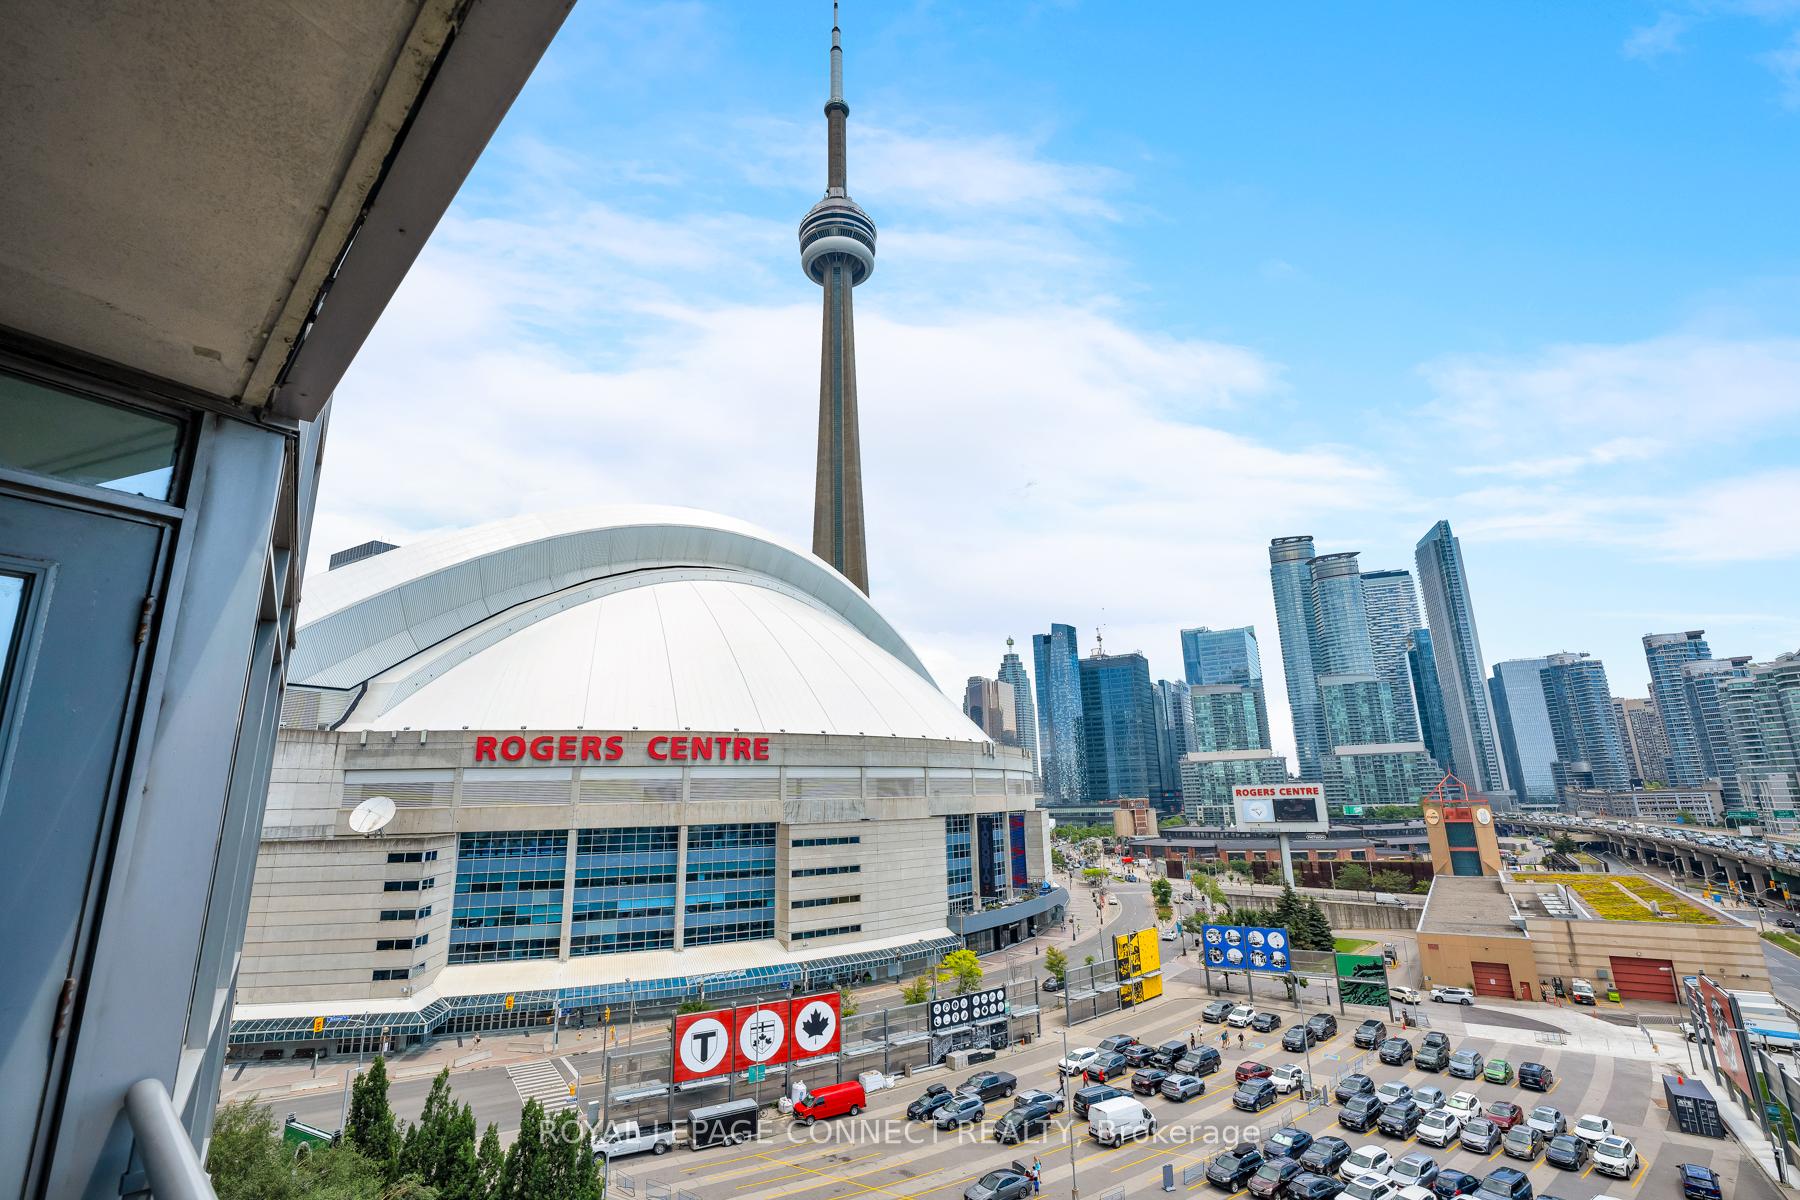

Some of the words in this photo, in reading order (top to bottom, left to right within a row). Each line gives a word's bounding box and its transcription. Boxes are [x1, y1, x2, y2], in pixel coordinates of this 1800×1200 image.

[475, 735, 624, 761] ROGERS
[647, 736, 769, 760] CENTRE
[1235, 788, 1275, 796] ROGERS
[1279, 787, 1319, 795] CENTRE
[693, 1031, 716, 1062] T
